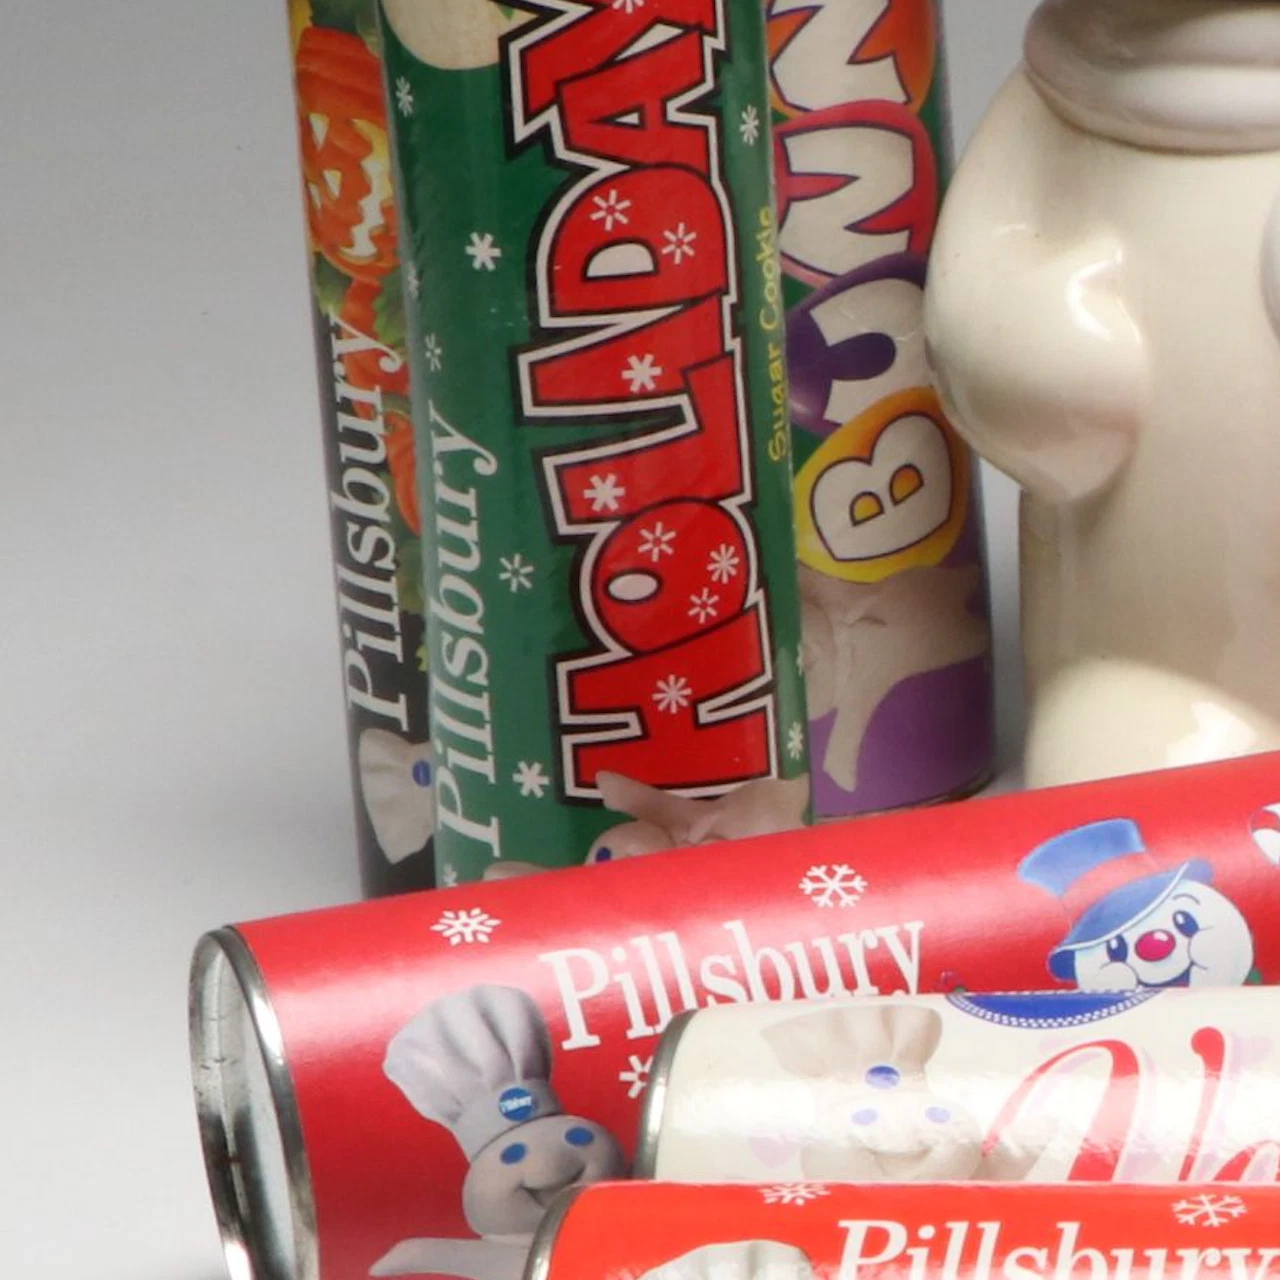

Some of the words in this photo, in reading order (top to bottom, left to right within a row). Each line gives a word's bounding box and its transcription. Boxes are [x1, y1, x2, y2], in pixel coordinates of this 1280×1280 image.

[755, 204, 781, 331] Cookie
[327, 312, 408, 733] Pillsbury
[429, 397, 502, 858] Pillsbury
[539, 918, 925, 1051] Pillsbury
